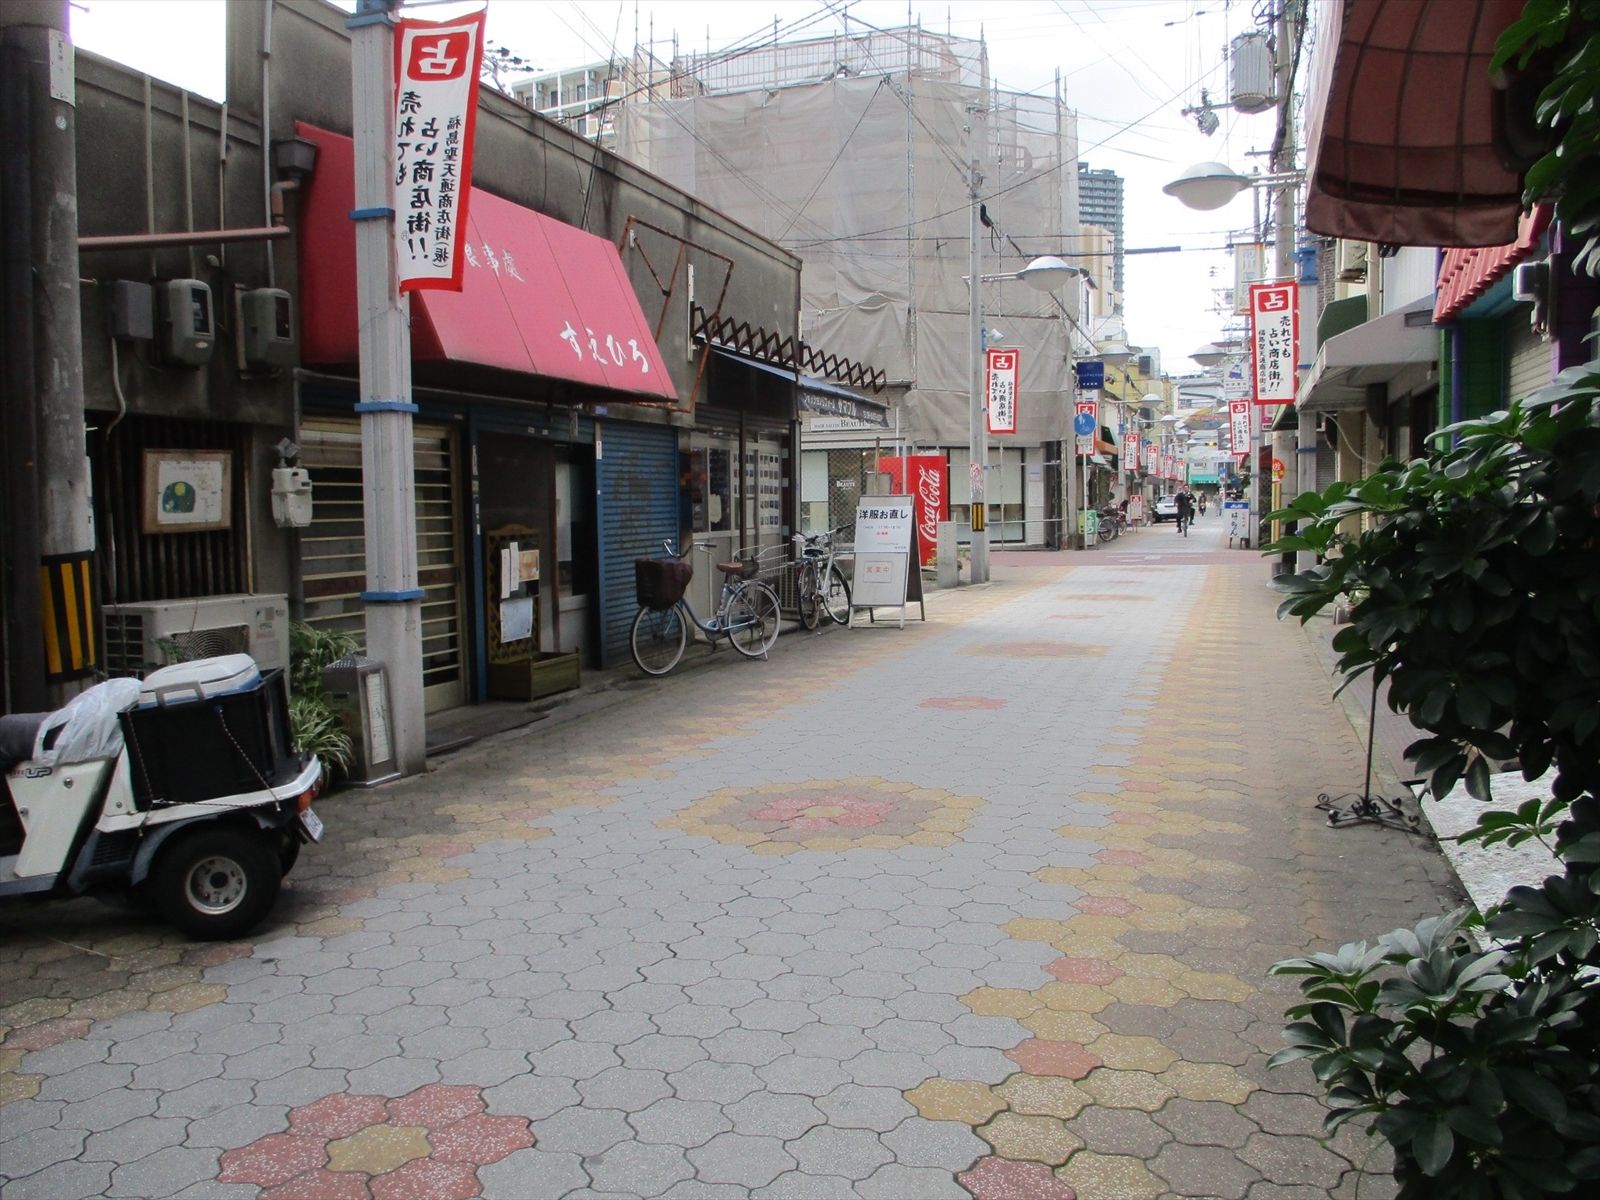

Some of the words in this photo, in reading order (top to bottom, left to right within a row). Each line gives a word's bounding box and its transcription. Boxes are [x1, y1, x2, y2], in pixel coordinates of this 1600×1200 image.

[1264, 293, 1284, 309] 占
[560, 320, 649, 373] すえひろ
[1279, 316, 1291, 358] 売れても
[858, 508, 909, 520] 洋服お直し
